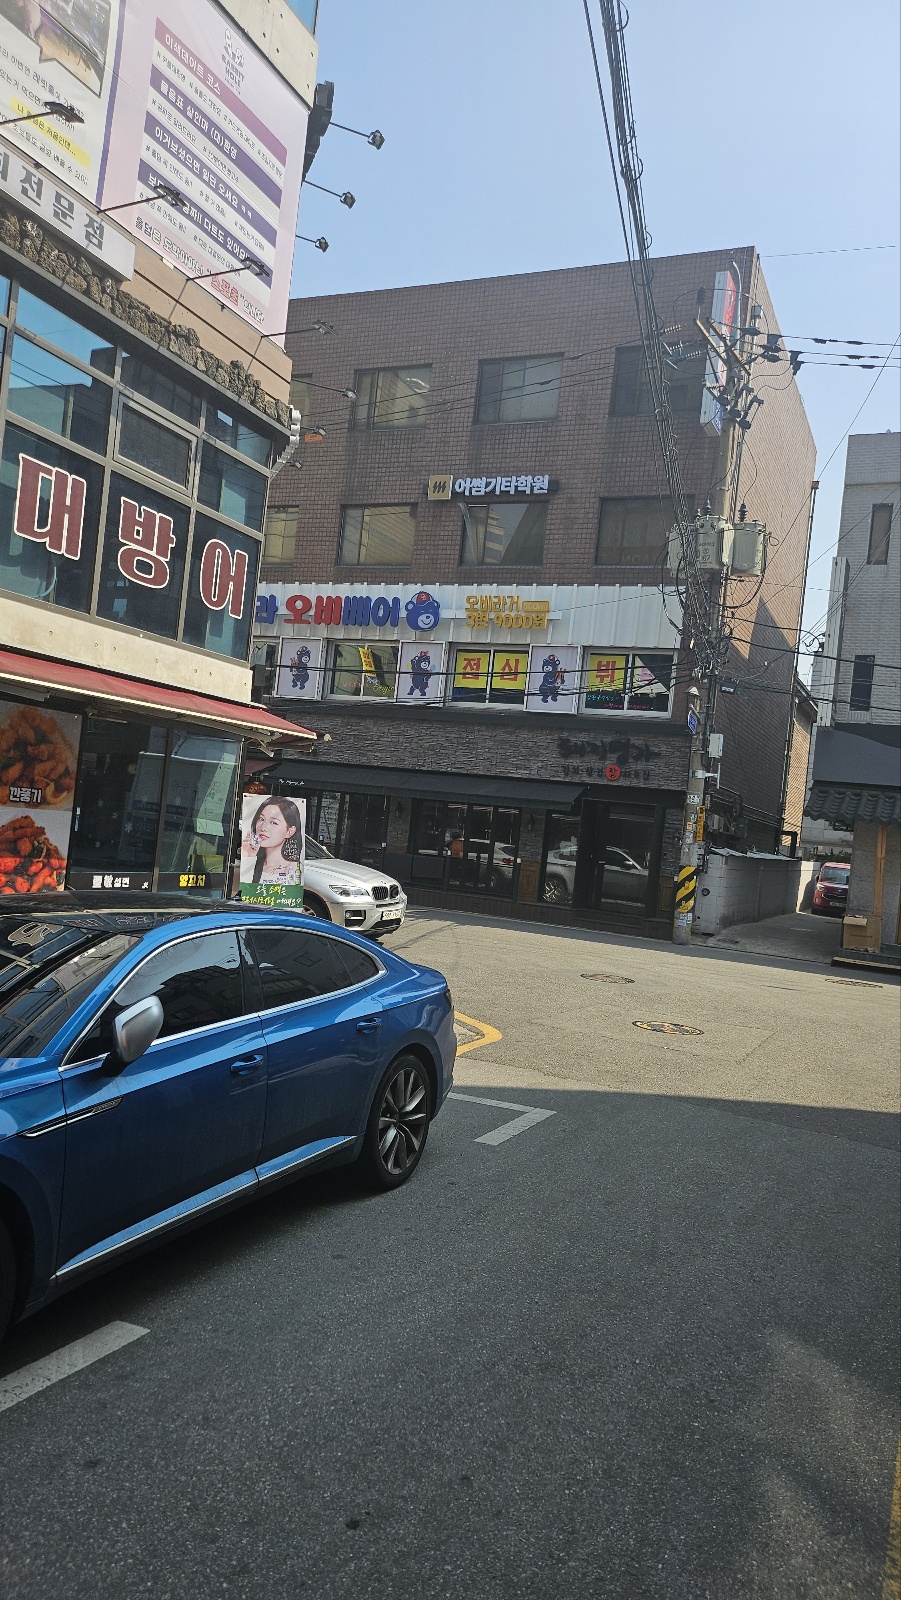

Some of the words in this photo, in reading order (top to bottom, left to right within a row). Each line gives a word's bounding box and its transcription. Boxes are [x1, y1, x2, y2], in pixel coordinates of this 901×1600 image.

[165, 34, 204, 75] 이색데이트
[205, 73, 221, 95] 코스
[225, 68, 241, 88] HOLE
[17, 104, 23, 113] 나
[161, 80, 184, 110] 물음표
[187, 106, 208, 132] 살인마
[202, 167, 216, 189] 일단
[218, 185, 238, 208] 오세요
[204, 218, 224, 242] 다트도
[454, 475, 549, 496] 어썸기타학원
[14, 453, 249, 619] 대방어
[465, 595, 520, 612] 오비라거
[465, 612, 489, 629] 3병
[493, 612, 549, 630] 9000원
[9, 786, 43, 804] 깐풍기
